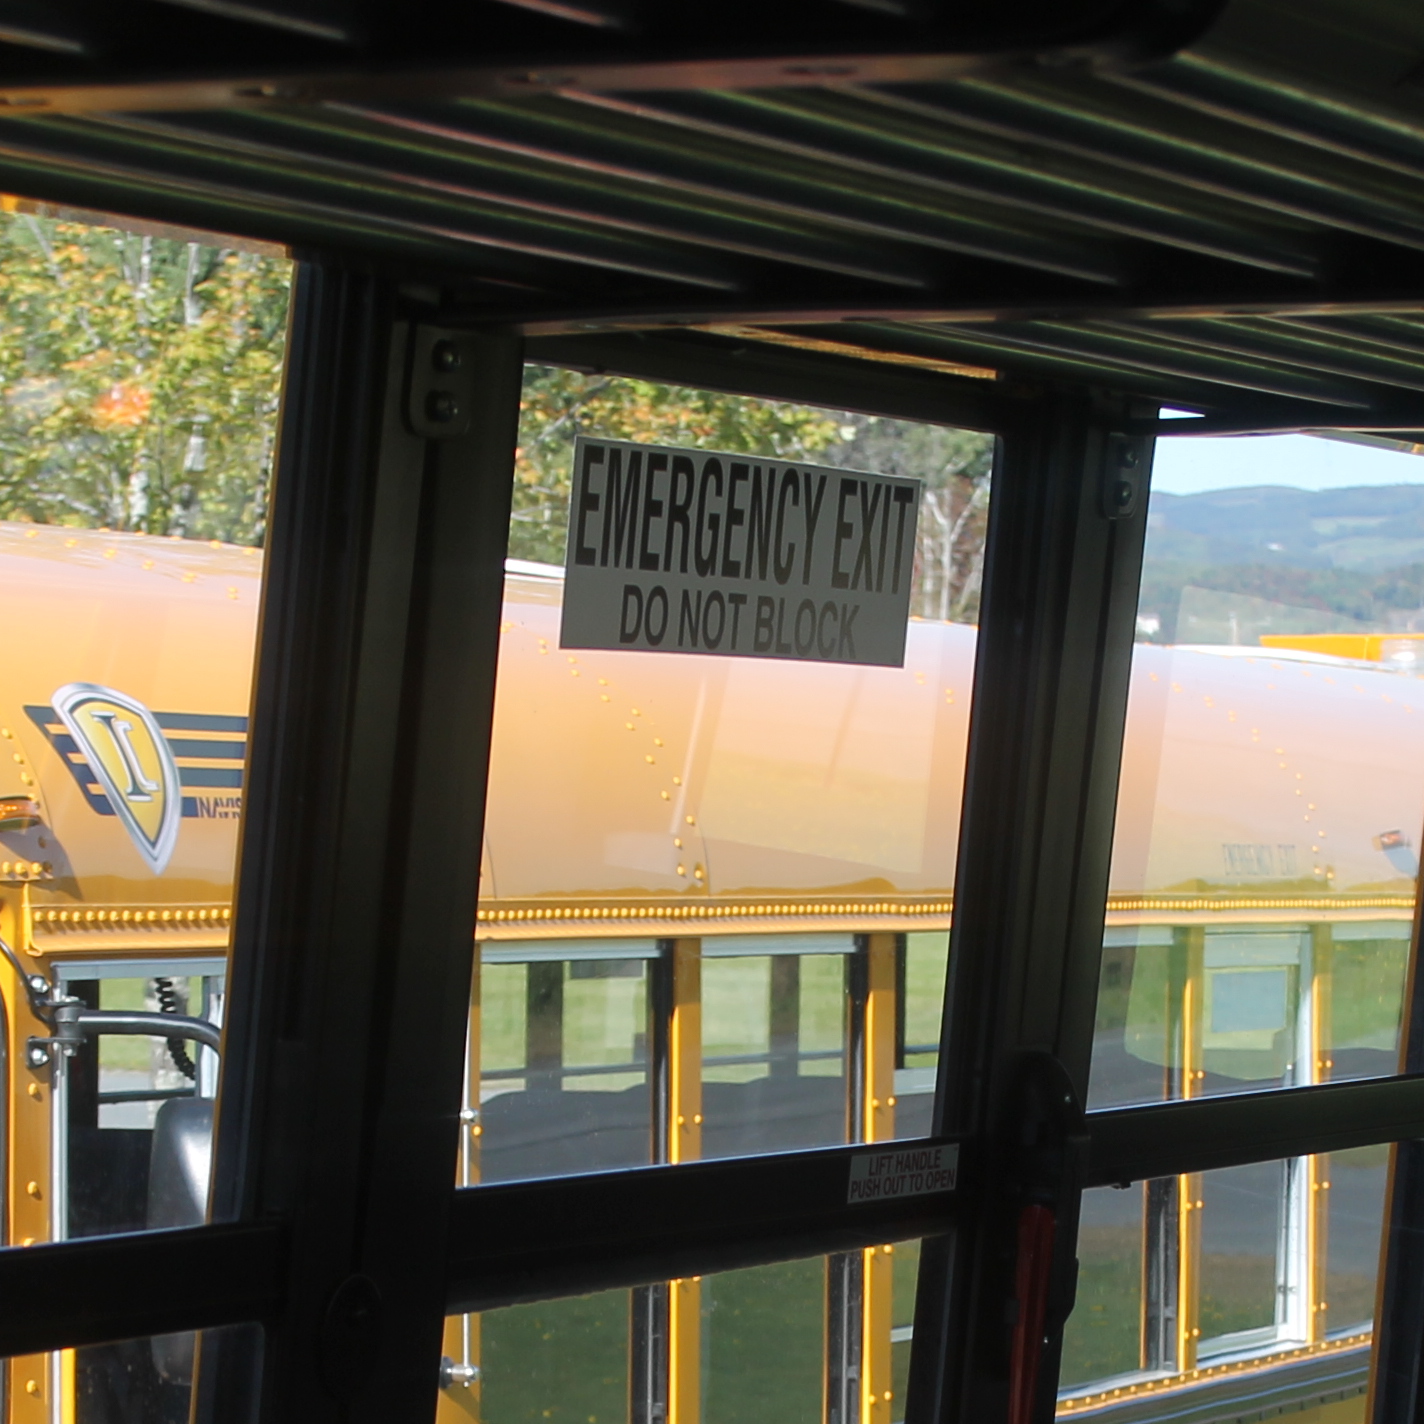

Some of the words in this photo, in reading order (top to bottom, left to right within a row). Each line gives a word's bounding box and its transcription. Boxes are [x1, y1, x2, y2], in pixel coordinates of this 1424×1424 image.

[575, 445, 827, 585] EMERGENCY
[831, 479, 914, 594] EXIT
[619, 584, 669, 645] DO
[678, 589, 747, 650] NOT
[753, 595, 861, 659] BLOCK
[850, 1177, 881, 1200] PUSH
[883, 1174, 907, 1196] OUT
[909, 1172, 924, 1191] TO
[926, 1168, 956, 1190] OPEN
[869, 1155, 893, 1176] LIFT
[895, 1149, 942, 1172] HANDLE
